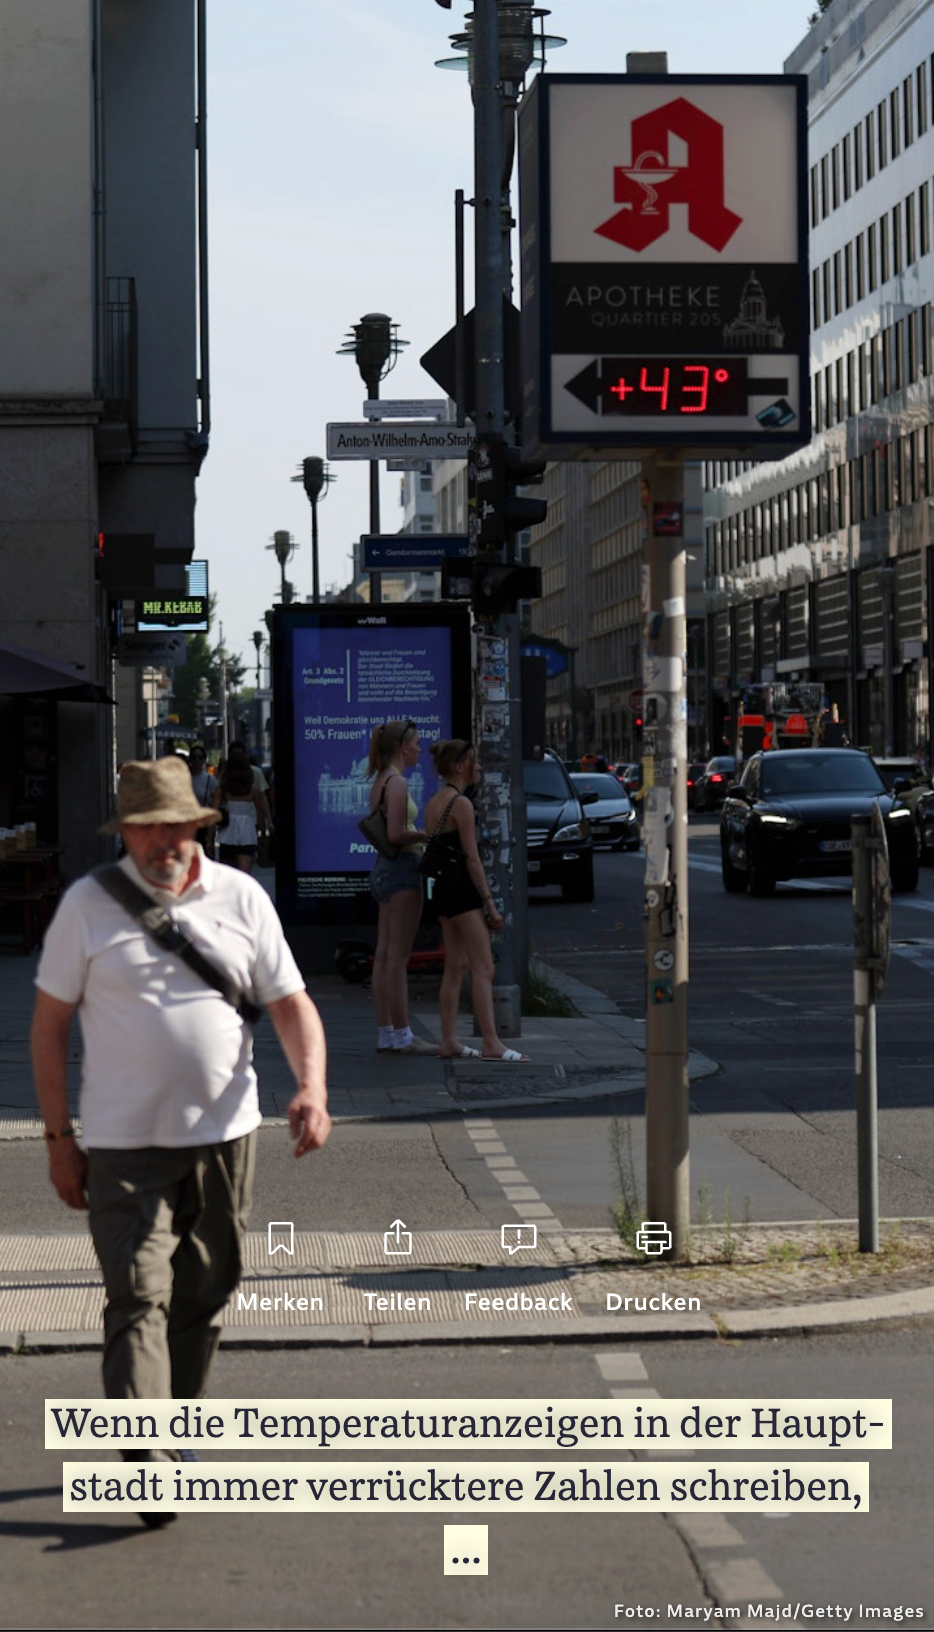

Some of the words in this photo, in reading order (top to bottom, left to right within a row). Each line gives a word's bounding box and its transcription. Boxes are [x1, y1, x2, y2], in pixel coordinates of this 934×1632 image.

[565, 286, 721, 307] APOTHEKE
[591, 312, 684, 327] QUARTIER
[688, 312, 722, 326] 205
[610, 365, 729, 412] +43°
[386, 548, 446, 558] Gendarmenmarkt
[316, 667, 321, 675] 3
[340, 667, 345, 675] 2
[304, 677, 344, 686] Grundgesetz
[304, 716, 323, 725] Weil
[323, 715, 368, 725] Demokratie
[370, 717, 385, 725] uns
[304, 729, 326, 740] 50%
